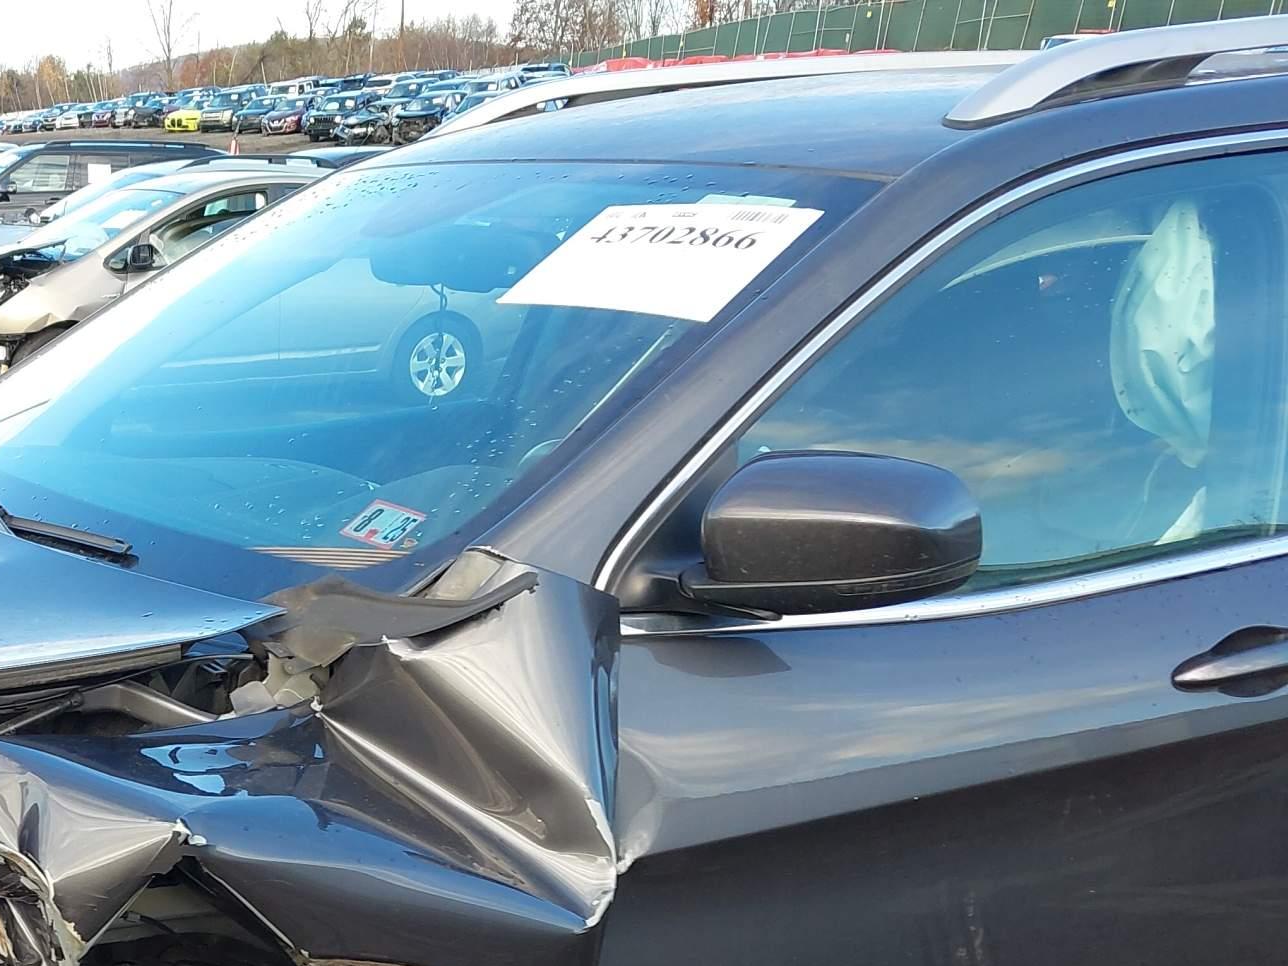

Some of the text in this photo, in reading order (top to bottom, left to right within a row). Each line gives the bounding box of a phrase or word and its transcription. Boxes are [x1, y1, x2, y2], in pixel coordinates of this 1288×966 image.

[590, 226, 765, 250] 43702866
[353, 508, 418, 543] 8 25
